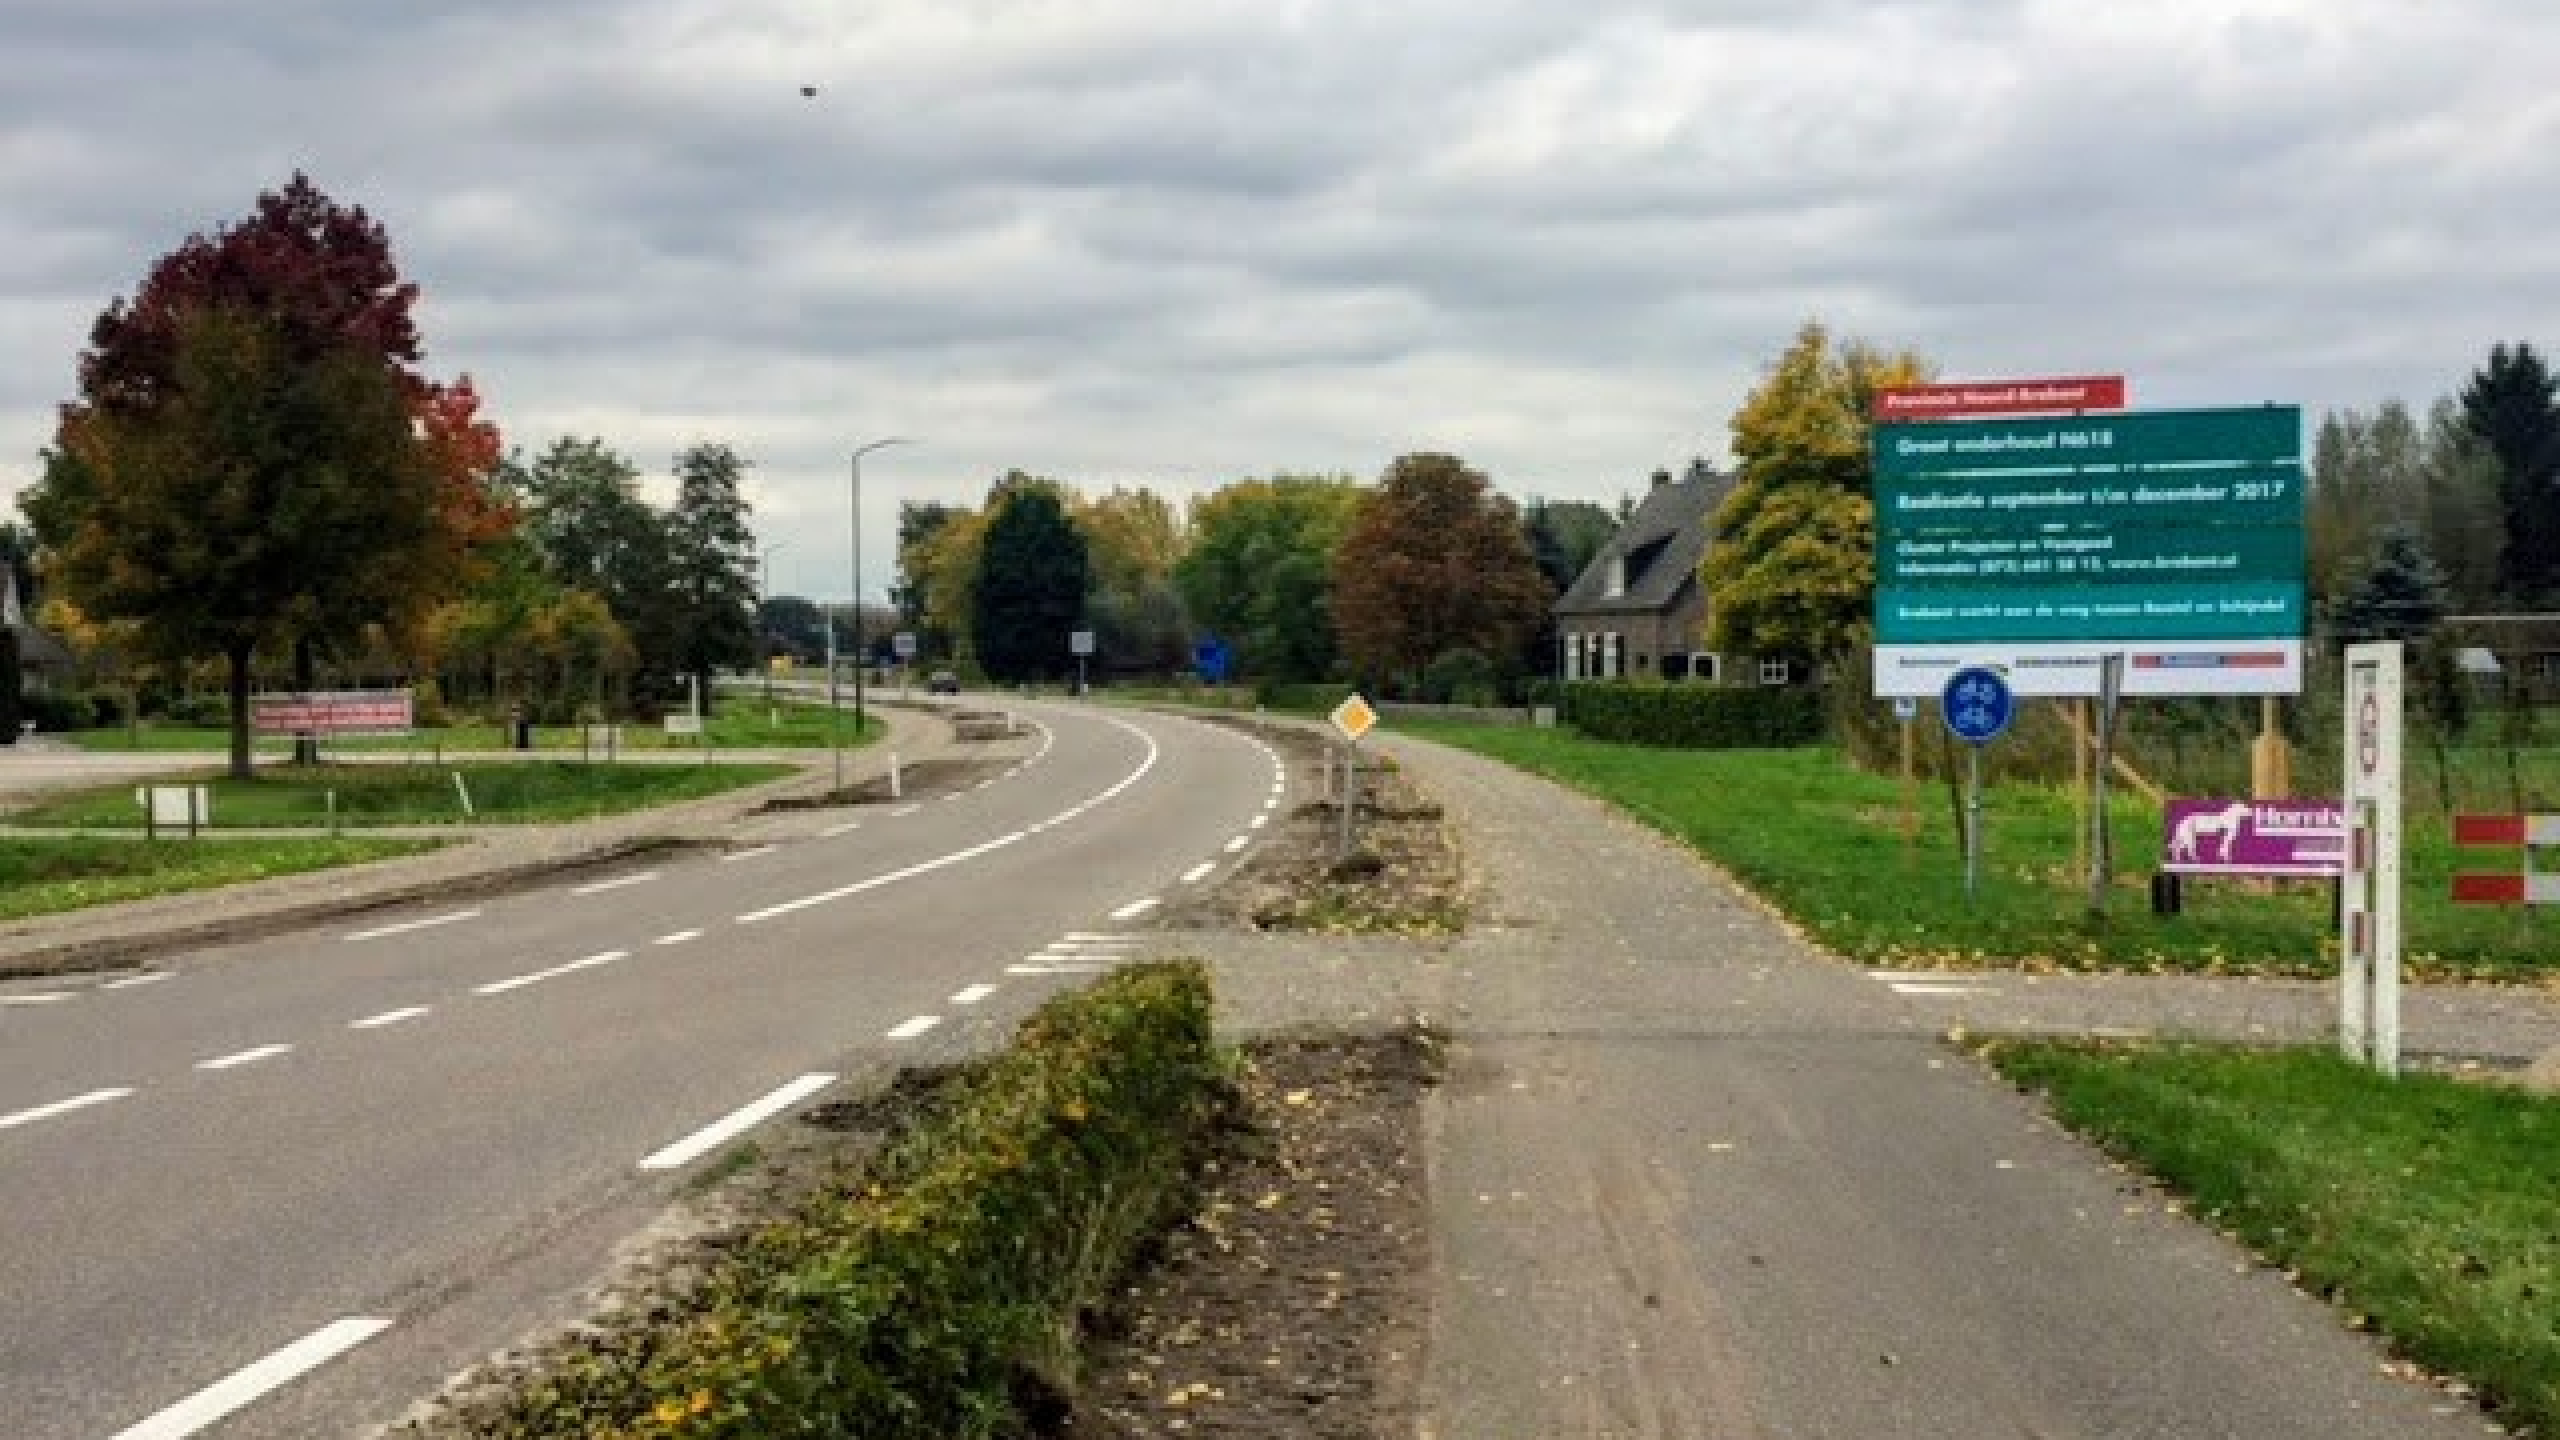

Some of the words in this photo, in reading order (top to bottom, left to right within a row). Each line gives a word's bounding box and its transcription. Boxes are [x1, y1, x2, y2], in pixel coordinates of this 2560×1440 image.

[1896, 436, 1949, 456] Groot
[1955, 432, 2056, 453] onderhoud
[1896, 491, 1985, 512] Realisatie
[1988, 488, 2085, 512] september
[2132, 484, 2228, 504] december
[2233, 480, 2285, 500] 2017
